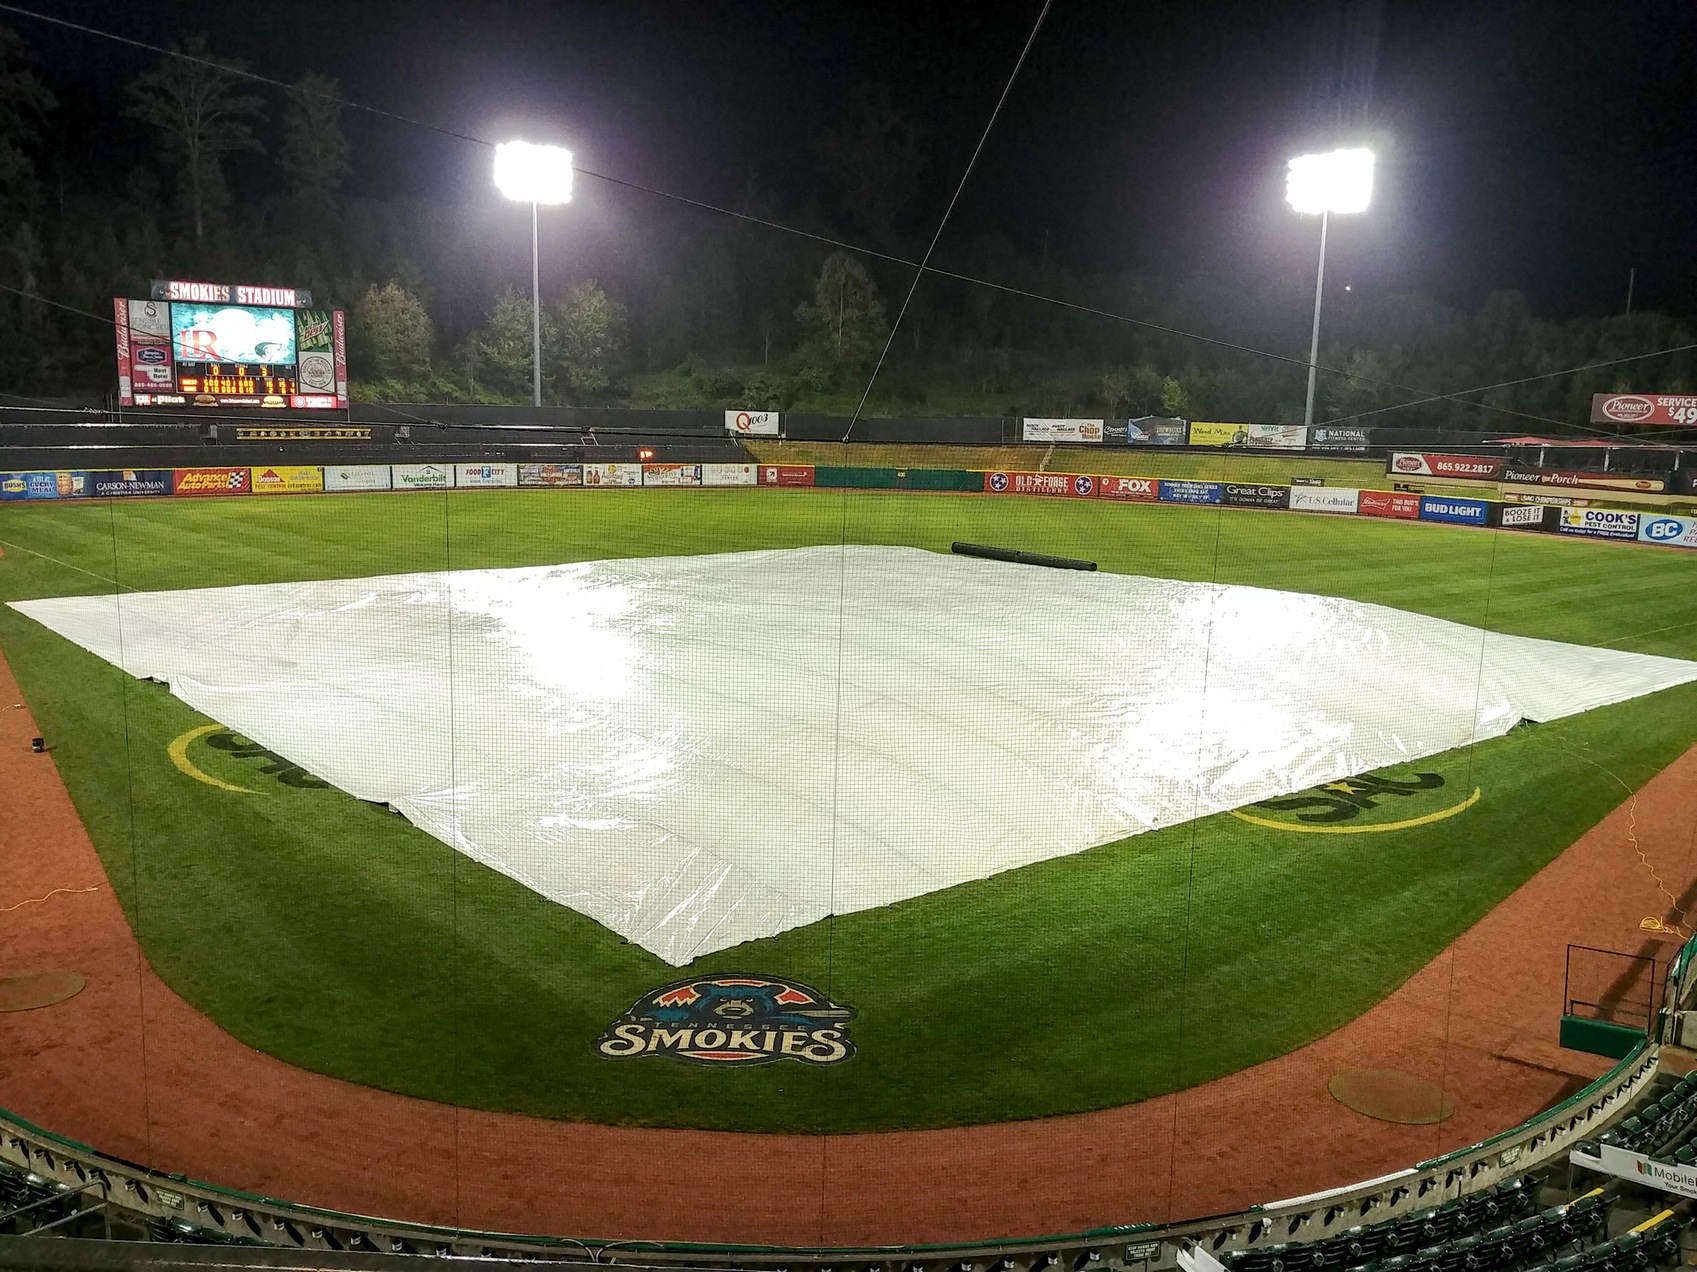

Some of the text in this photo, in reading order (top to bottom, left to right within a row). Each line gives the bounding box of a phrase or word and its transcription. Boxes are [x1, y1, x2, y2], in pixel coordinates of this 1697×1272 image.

[170, 282, 295, 306] SMOKIES STADIUM
[118, 301, 130, 360] Budweiser
[336, 314, 347, 368] Budweiser
[1612, 400, 1650, 410] Pioneer
[1079, 425, 1099, 435] Chop
[1437, 462, 1494, 474] 865.922.2817
[184, 472, 227, 483] Advance
[402, 475, 446, 483] Vanderbilt
[1015, 475, 1068, 487] OLD FORGE
[1505, 470, 1578, 485] Pioneer Porch
[96, 481, 165, 490] CARSON-NEWMAN
[179, 481, 201, 490] Auto
[1118, 479, 1152, 492] FOX
[1227, 485, 1284, 498] Great Clips
[1322, 497, 1354, 506] Cellular
[1425, 503, 1482, 516] BUD LIGHT
[1505, 508, 1531, 516] BOOZE
[1586, 511, 1636, 524] COOK'S
[1652, 522, 1678, 537] BC
[654, 1021, 808, 1031] TENNESSEE
[600, 1024, 847, 1063] SMOKIES
